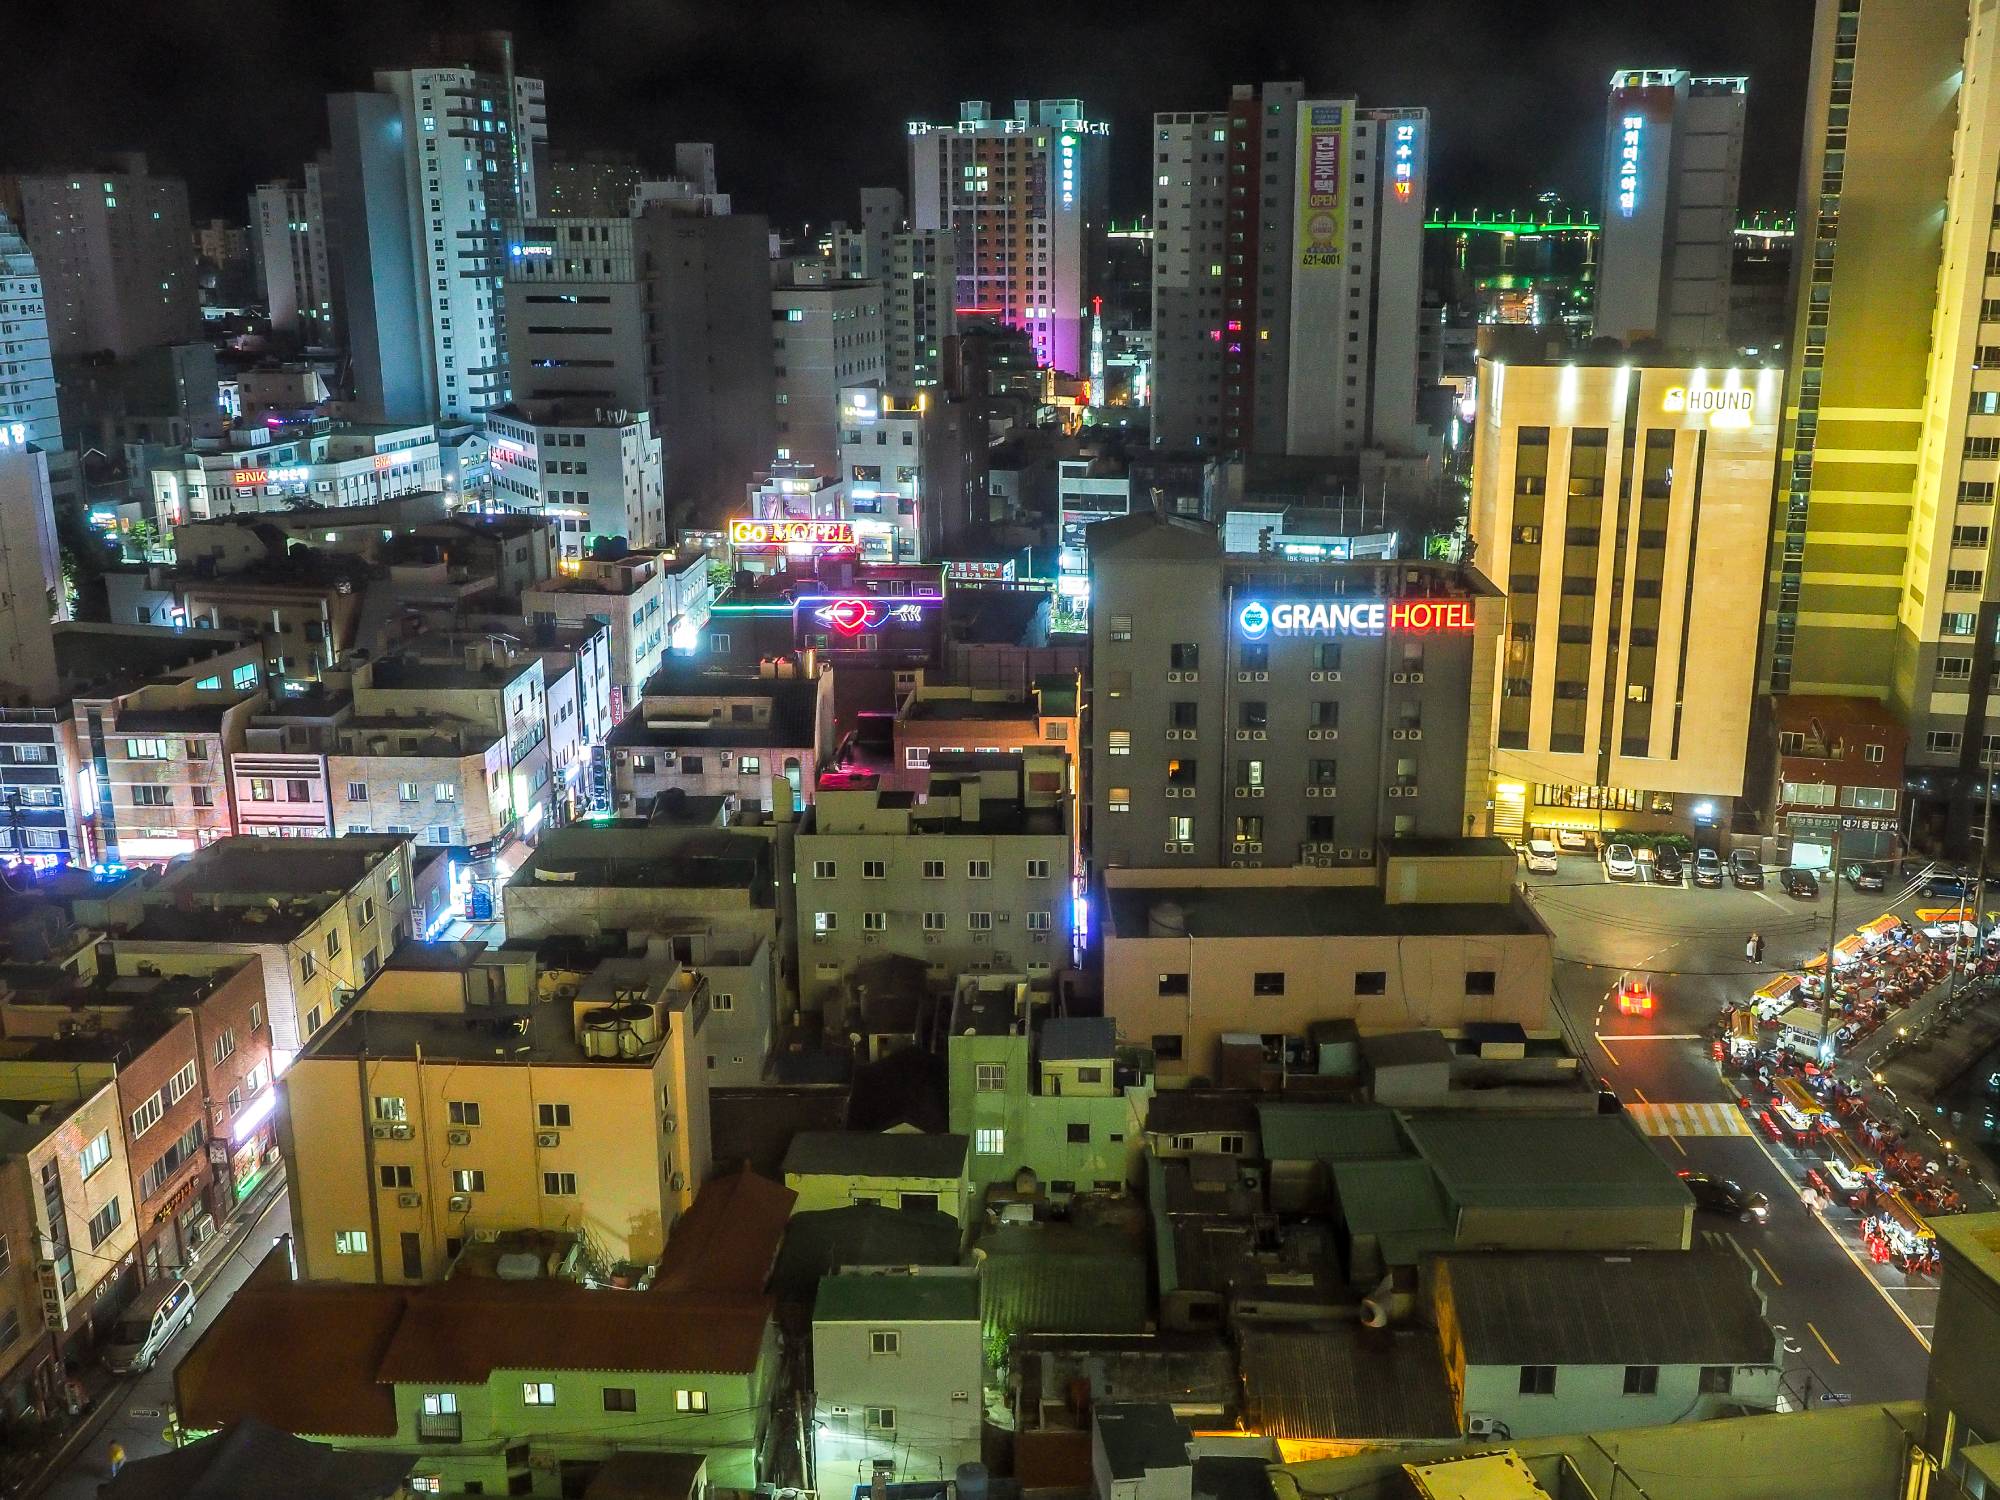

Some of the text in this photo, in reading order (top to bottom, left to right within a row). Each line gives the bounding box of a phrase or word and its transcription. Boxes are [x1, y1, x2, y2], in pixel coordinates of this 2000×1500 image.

[1310, 194, 1337, 207] OPEN
[1302, 254, 1341, 265] 621-4001
[1690, 391, 1752, 410] HOUND
[235, 471, 268, 484] BNK
[734, 522, 852, 543] Go MOTEL
[1271, 603, 1476, 630] GRANCE HOTEL
